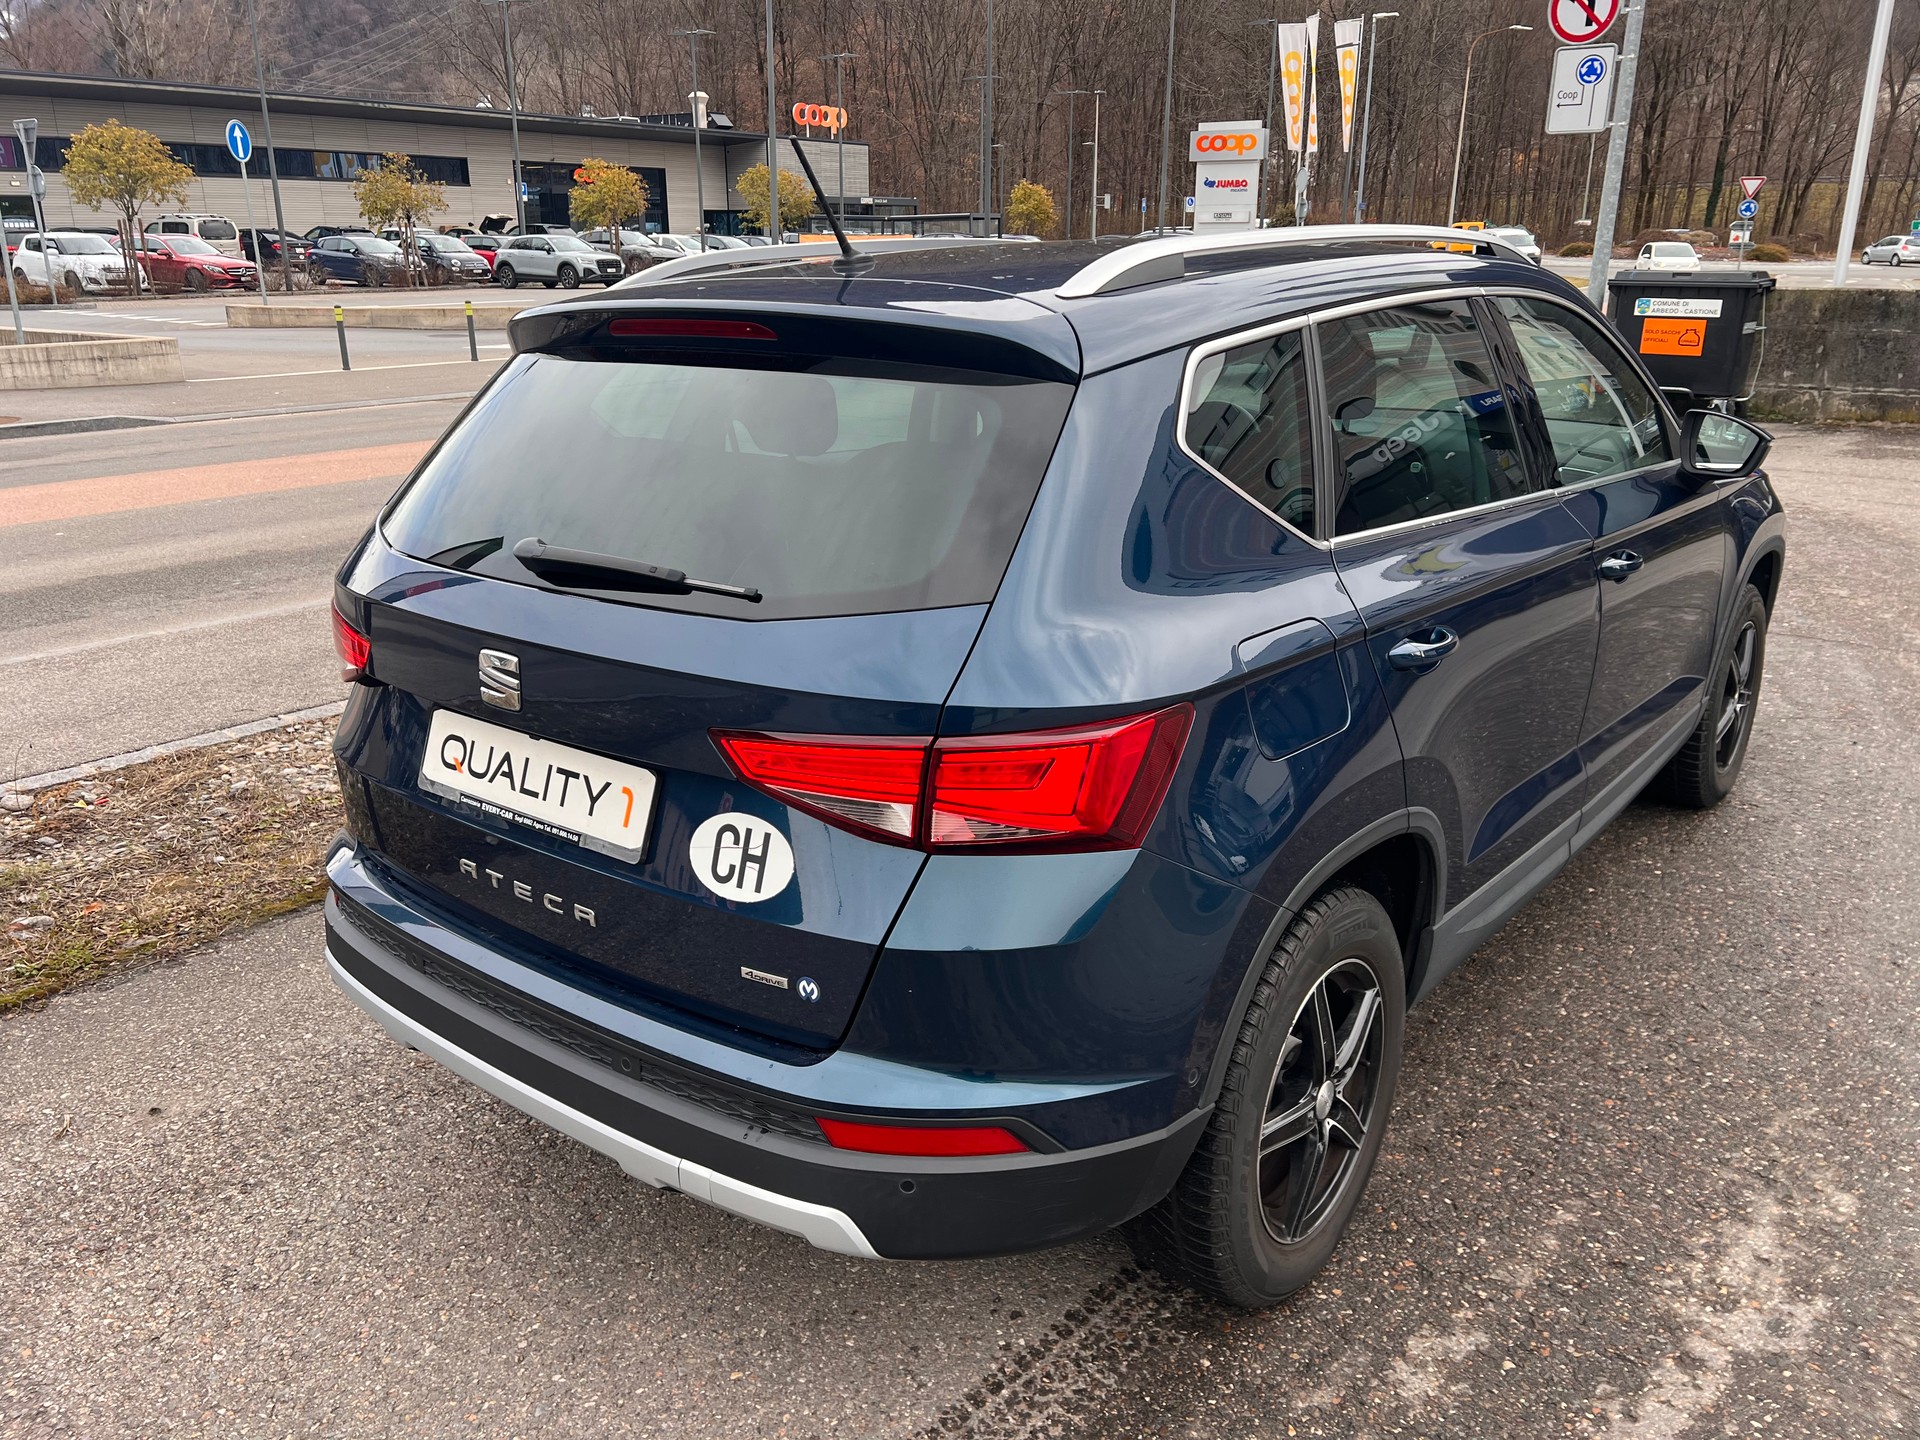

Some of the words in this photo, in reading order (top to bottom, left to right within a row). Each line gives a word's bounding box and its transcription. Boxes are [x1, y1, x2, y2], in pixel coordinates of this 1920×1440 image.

[1557, 90, 1578, 101] Coop
[793, 102, 848, 134] coop
[1196, 134, 1257, 155] coop
[1215, 180, 1248, 188] JUMBO
[441, 734, 612, 817] QUALITY
[481, 802, 514, 820] EVERY-CAR
[711, 823, 771, 893] CH
[459, 858, 597, 928] ATECA
[744, 970, 785, 988] 4DRIVE
